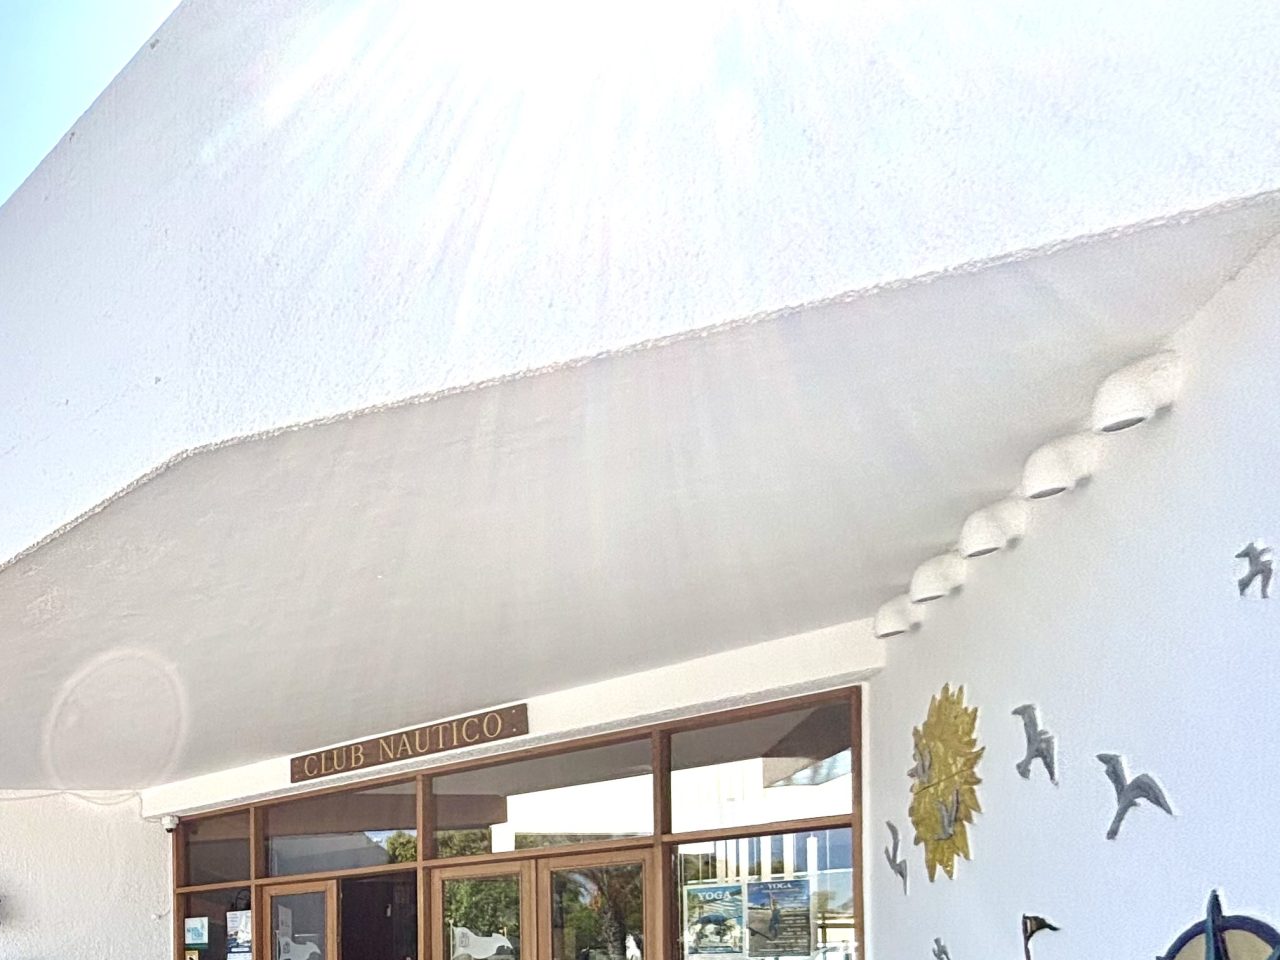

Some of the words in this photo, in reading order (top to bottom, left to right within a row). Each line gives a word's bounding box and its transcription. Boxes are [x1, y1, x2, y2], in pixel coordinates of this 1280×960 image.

[303, 744, 364, 777] CLUB
[378, 712, 502, 761] NAUTICO
[767, 882, 793, 890] YOGA
[697, 891, 732, 901] YOGA
